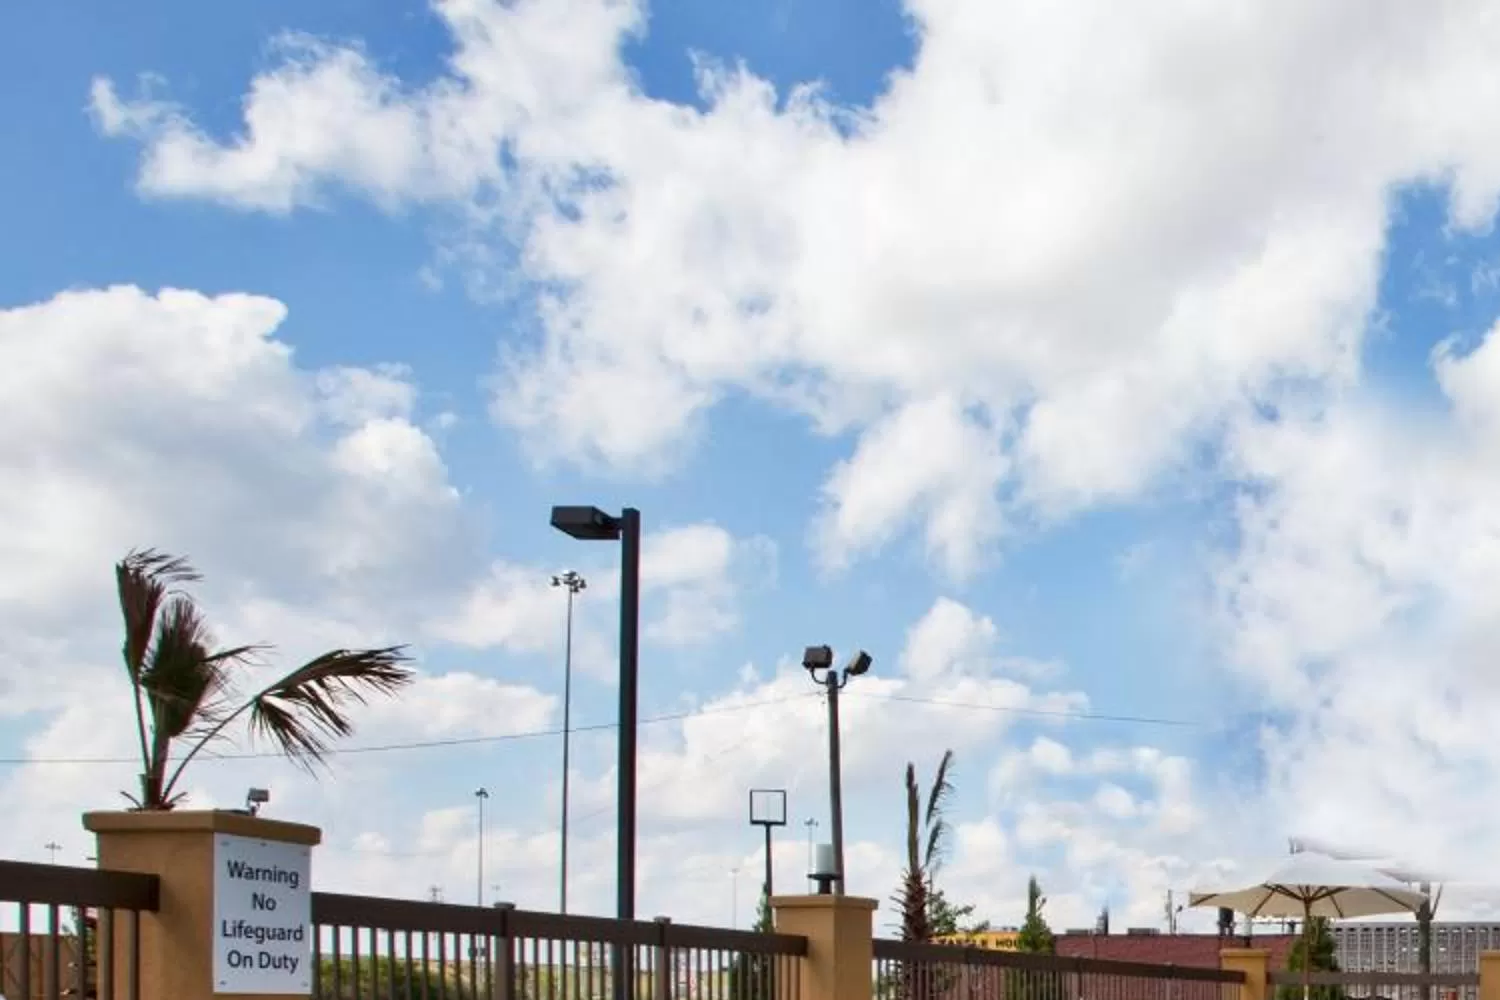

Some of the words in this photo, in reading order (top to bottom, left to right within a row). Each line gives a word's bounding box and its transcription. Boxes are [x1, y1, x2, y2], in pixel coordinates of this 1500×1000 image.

[227, 860, 299, 889] Warning
[252, 892, 277, 911] No
[221, 919, 304, 944] Lifeguard
[227, 949, 253, 968] On
[258, 951, 299, 975] Duty
